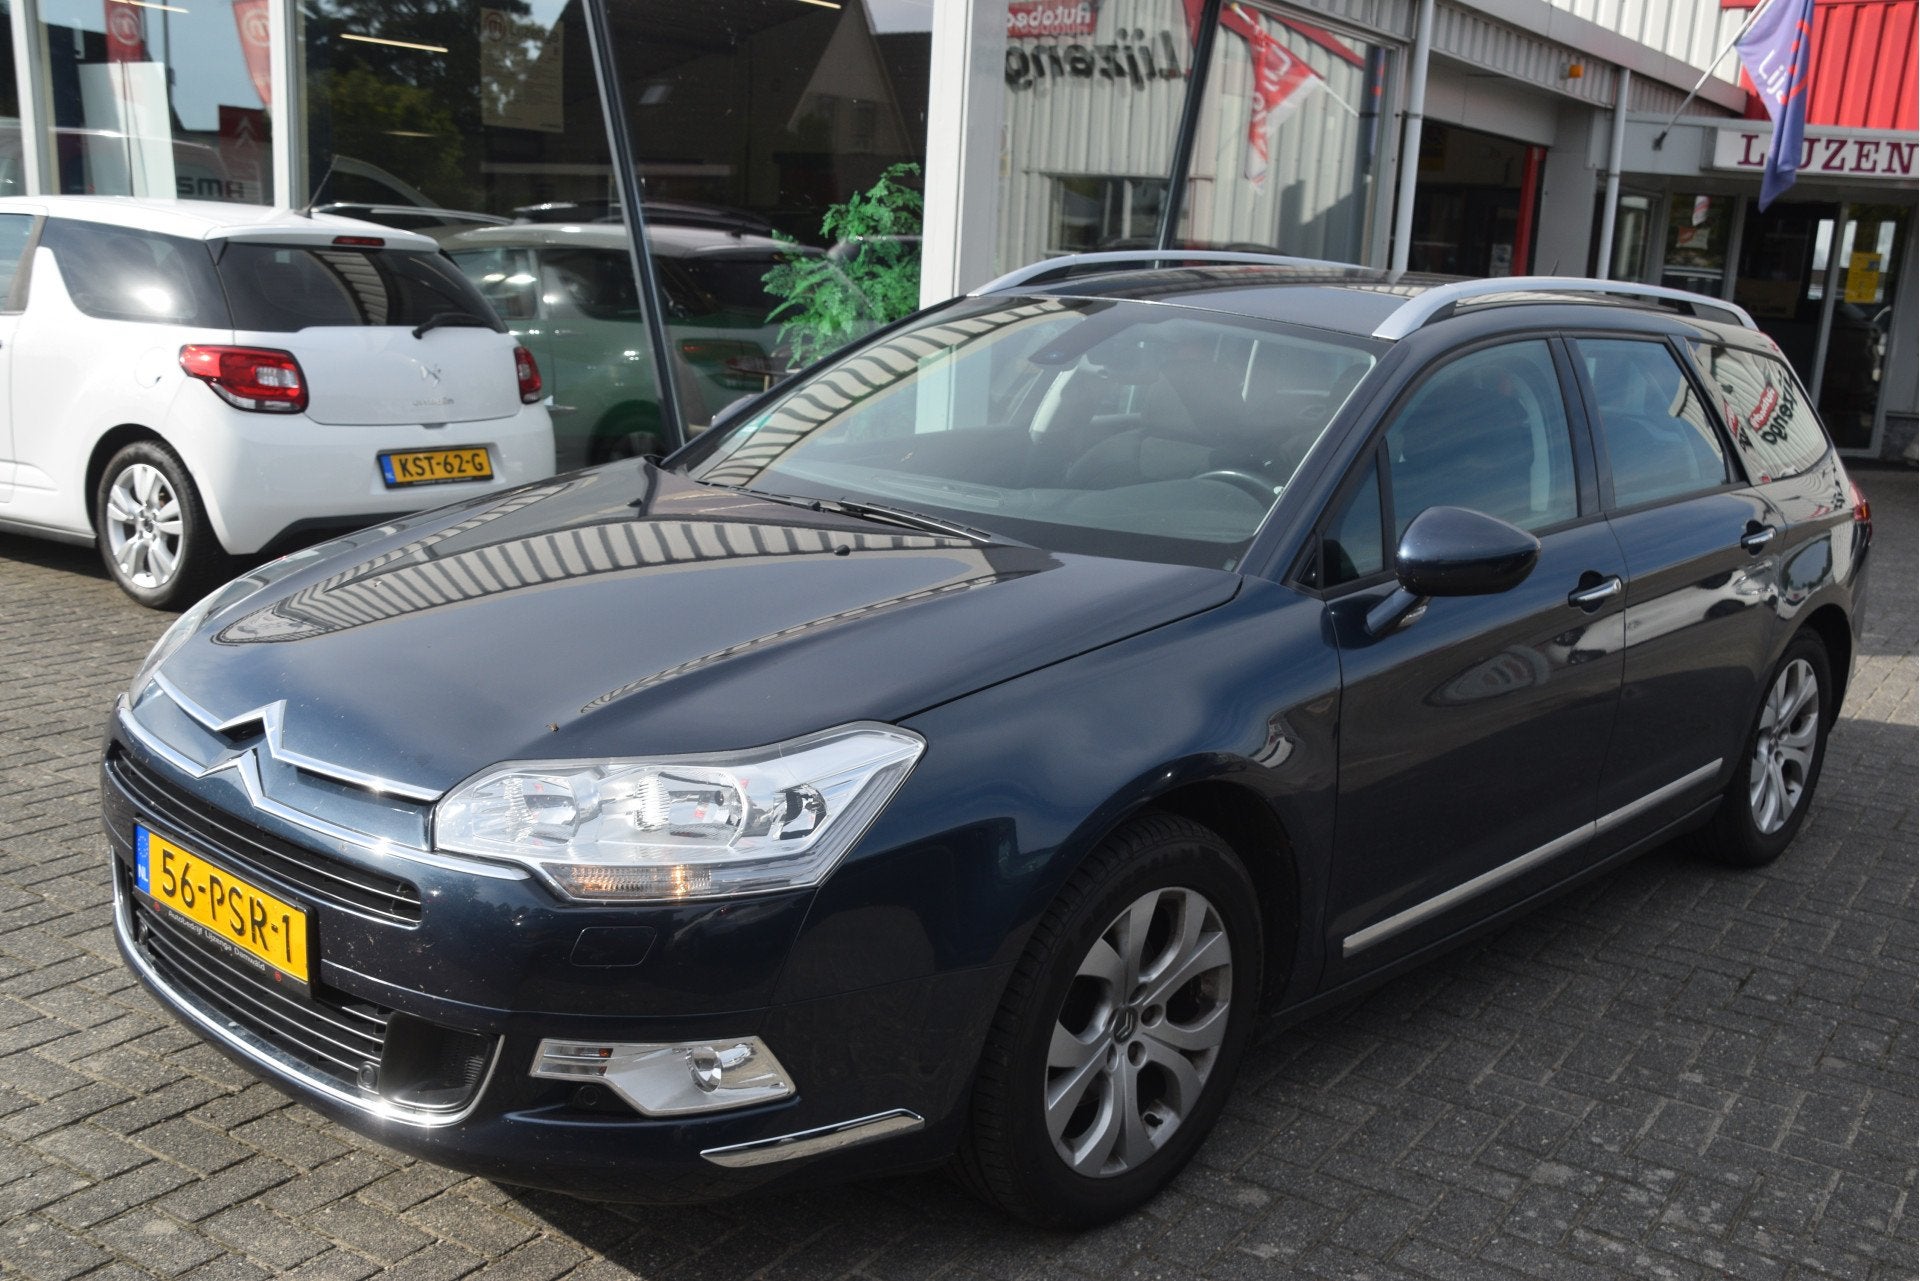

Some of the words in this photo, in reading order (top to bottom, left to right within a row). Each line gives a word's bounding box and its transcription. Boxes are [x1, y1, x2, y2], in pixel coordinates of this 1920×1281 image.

[1737, 134, 1919, 174] LJZEN
[399, 453, 484, 478] KST-62-G
[137, 864, 149, 882] NL
[162, 849, 292, 963] 56-PSR-1
